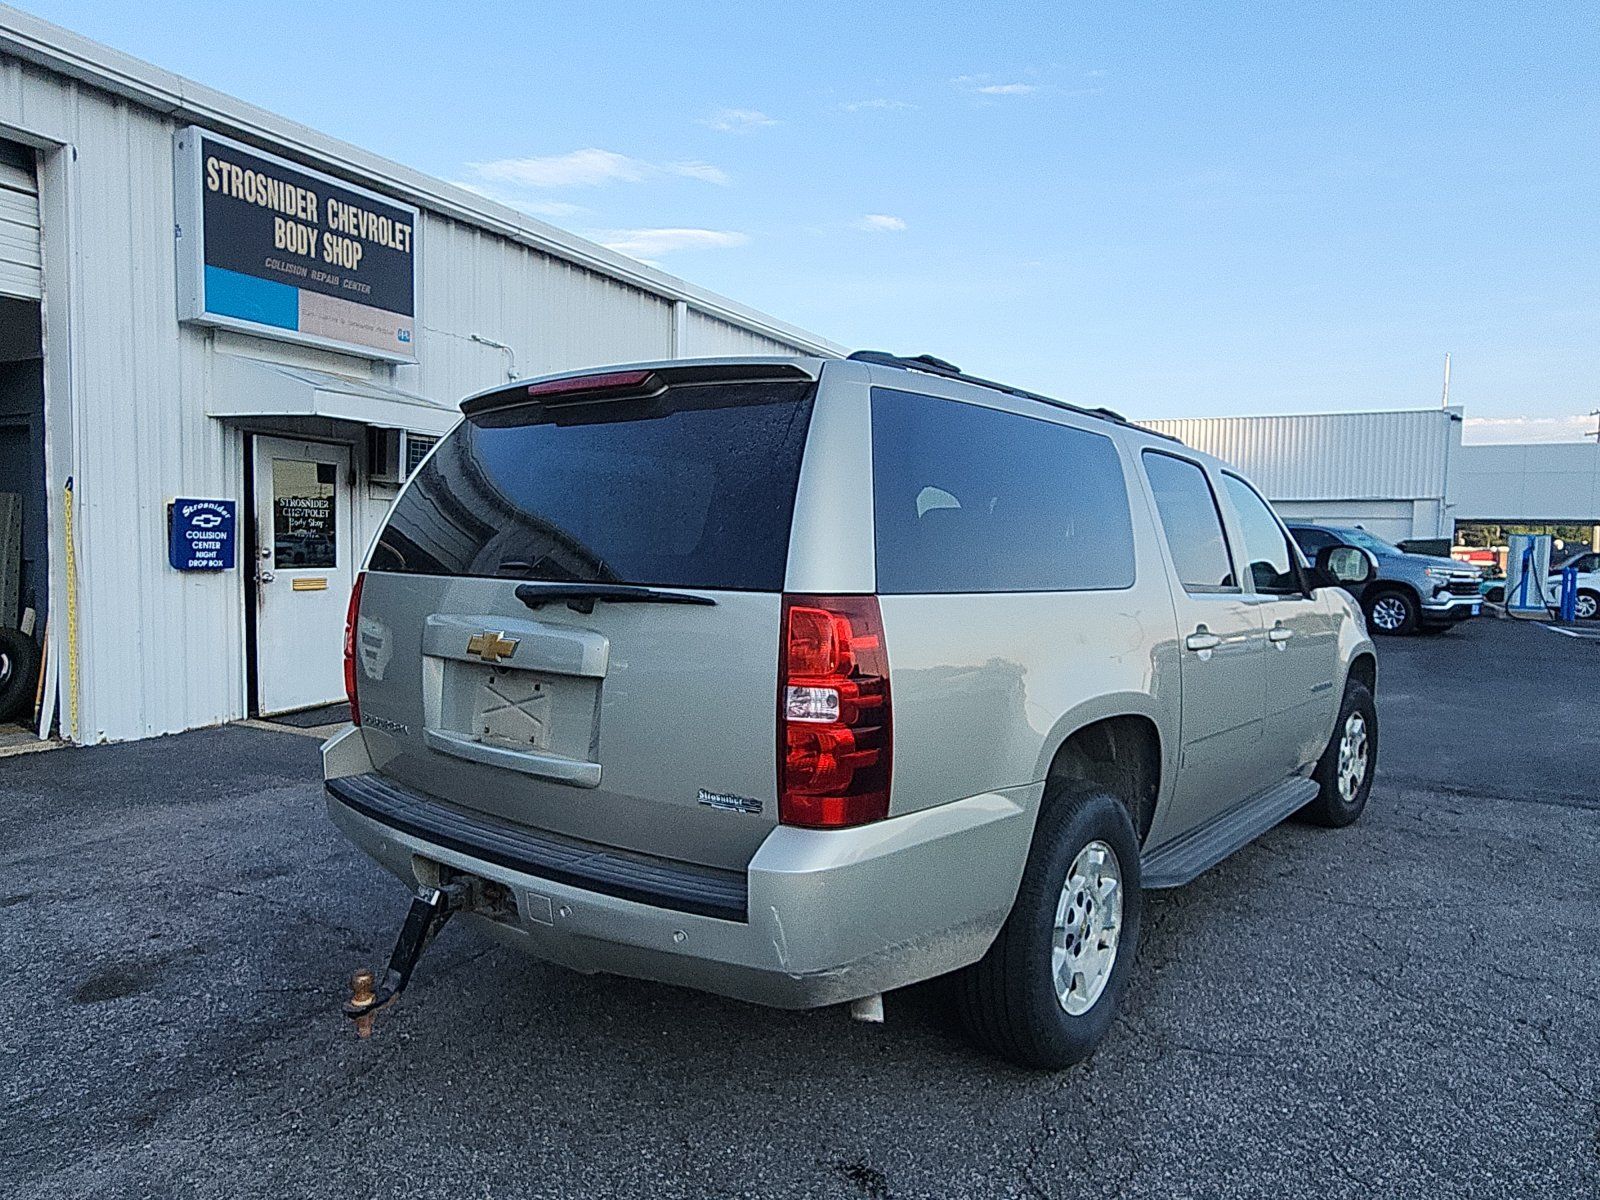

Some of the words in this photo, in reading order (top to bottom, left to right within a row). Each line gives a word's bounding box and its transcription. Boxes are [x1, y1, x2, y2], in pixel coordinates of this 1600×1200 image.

[206, 156, 319, 223] STROSNIDER
[327, 198, 412, 253] CHEVROLET
[274, 217, 318, 258] BODY
[323, 232, 362, 271] SHOP
[265, 257, 308, 277] COLLISION
[311, 269, 340, 286] REPAIR
[343, 279, 372, 294] CENTER
[279, 497, 329, 508] STROSNIDER
[182, 502, 231, 519] Strosnider
[185, 531, 228, 540] COLLISION
[191, 540, 221, 550] CENTER
[195, 551, 218, 559] NIGHT
[188, 560, 208, 568] DROP
[208, 560, 224, 568] BOX
